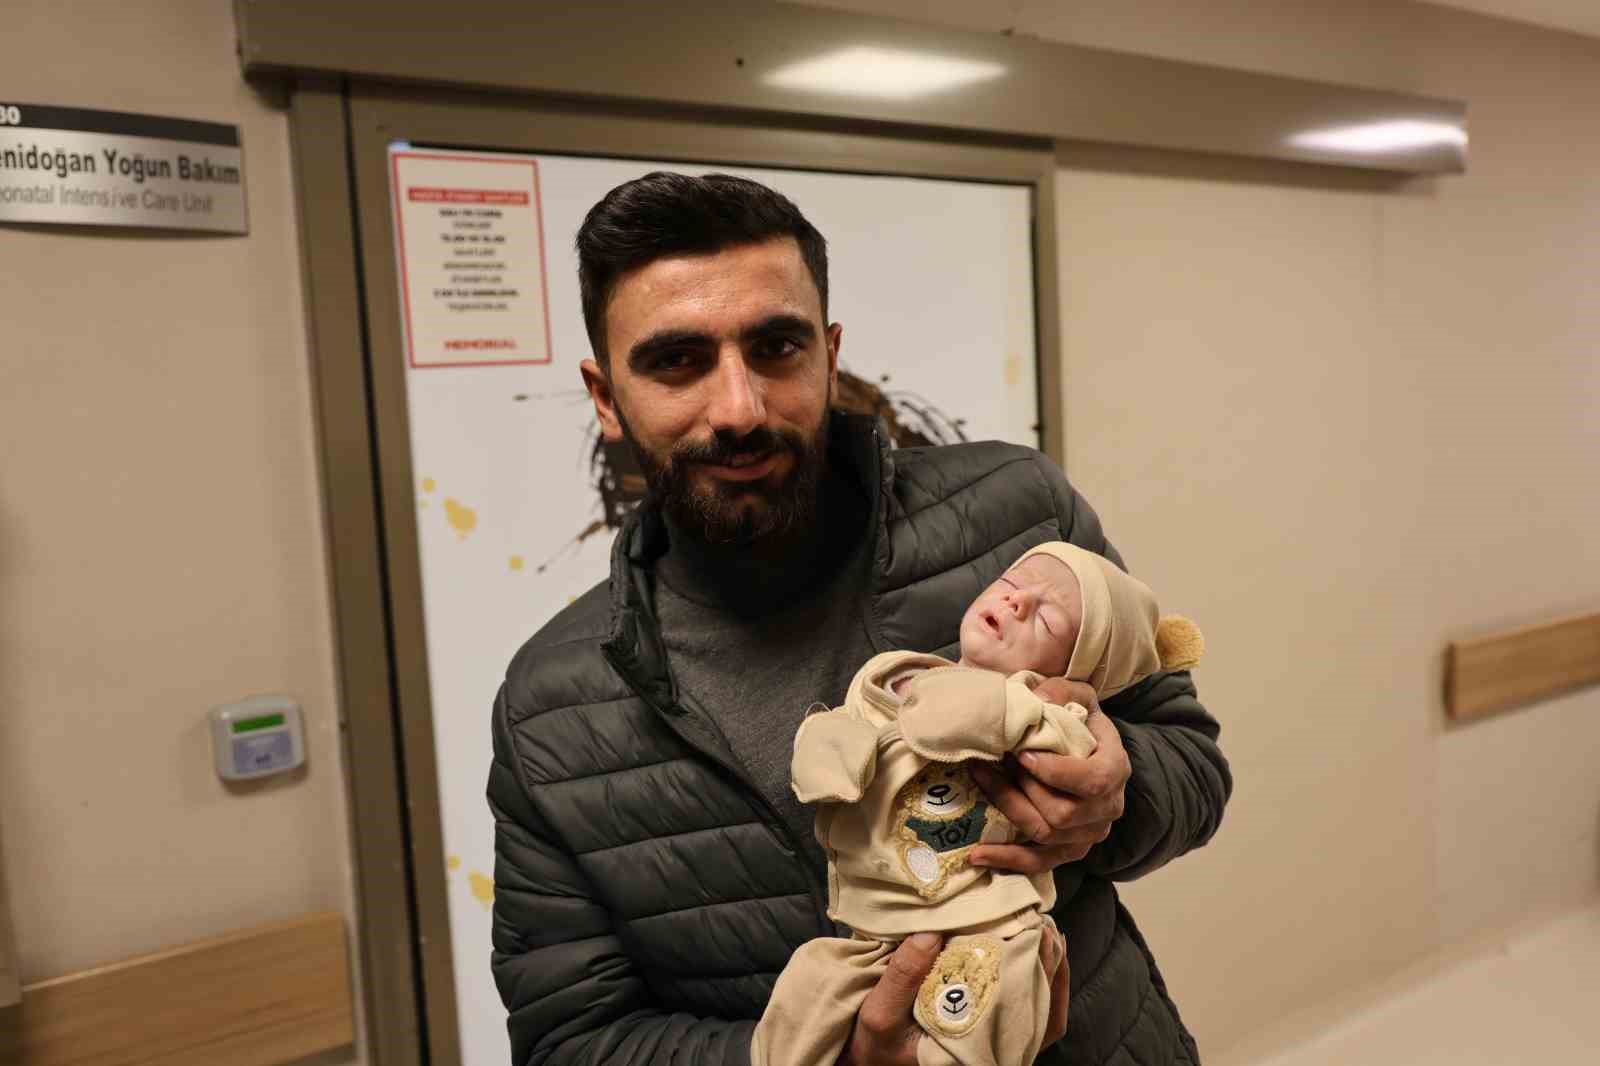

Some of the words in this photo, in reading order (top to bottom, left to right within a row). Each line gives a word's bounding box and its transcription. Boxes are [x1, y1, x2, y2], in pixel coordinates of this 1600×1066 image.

[103, 149, 171, 183] Yoğun
[60, 186, 137, 210] Intensive
[143, 189, 181, 212] Care
[930, 816, 973, 849] TOY
